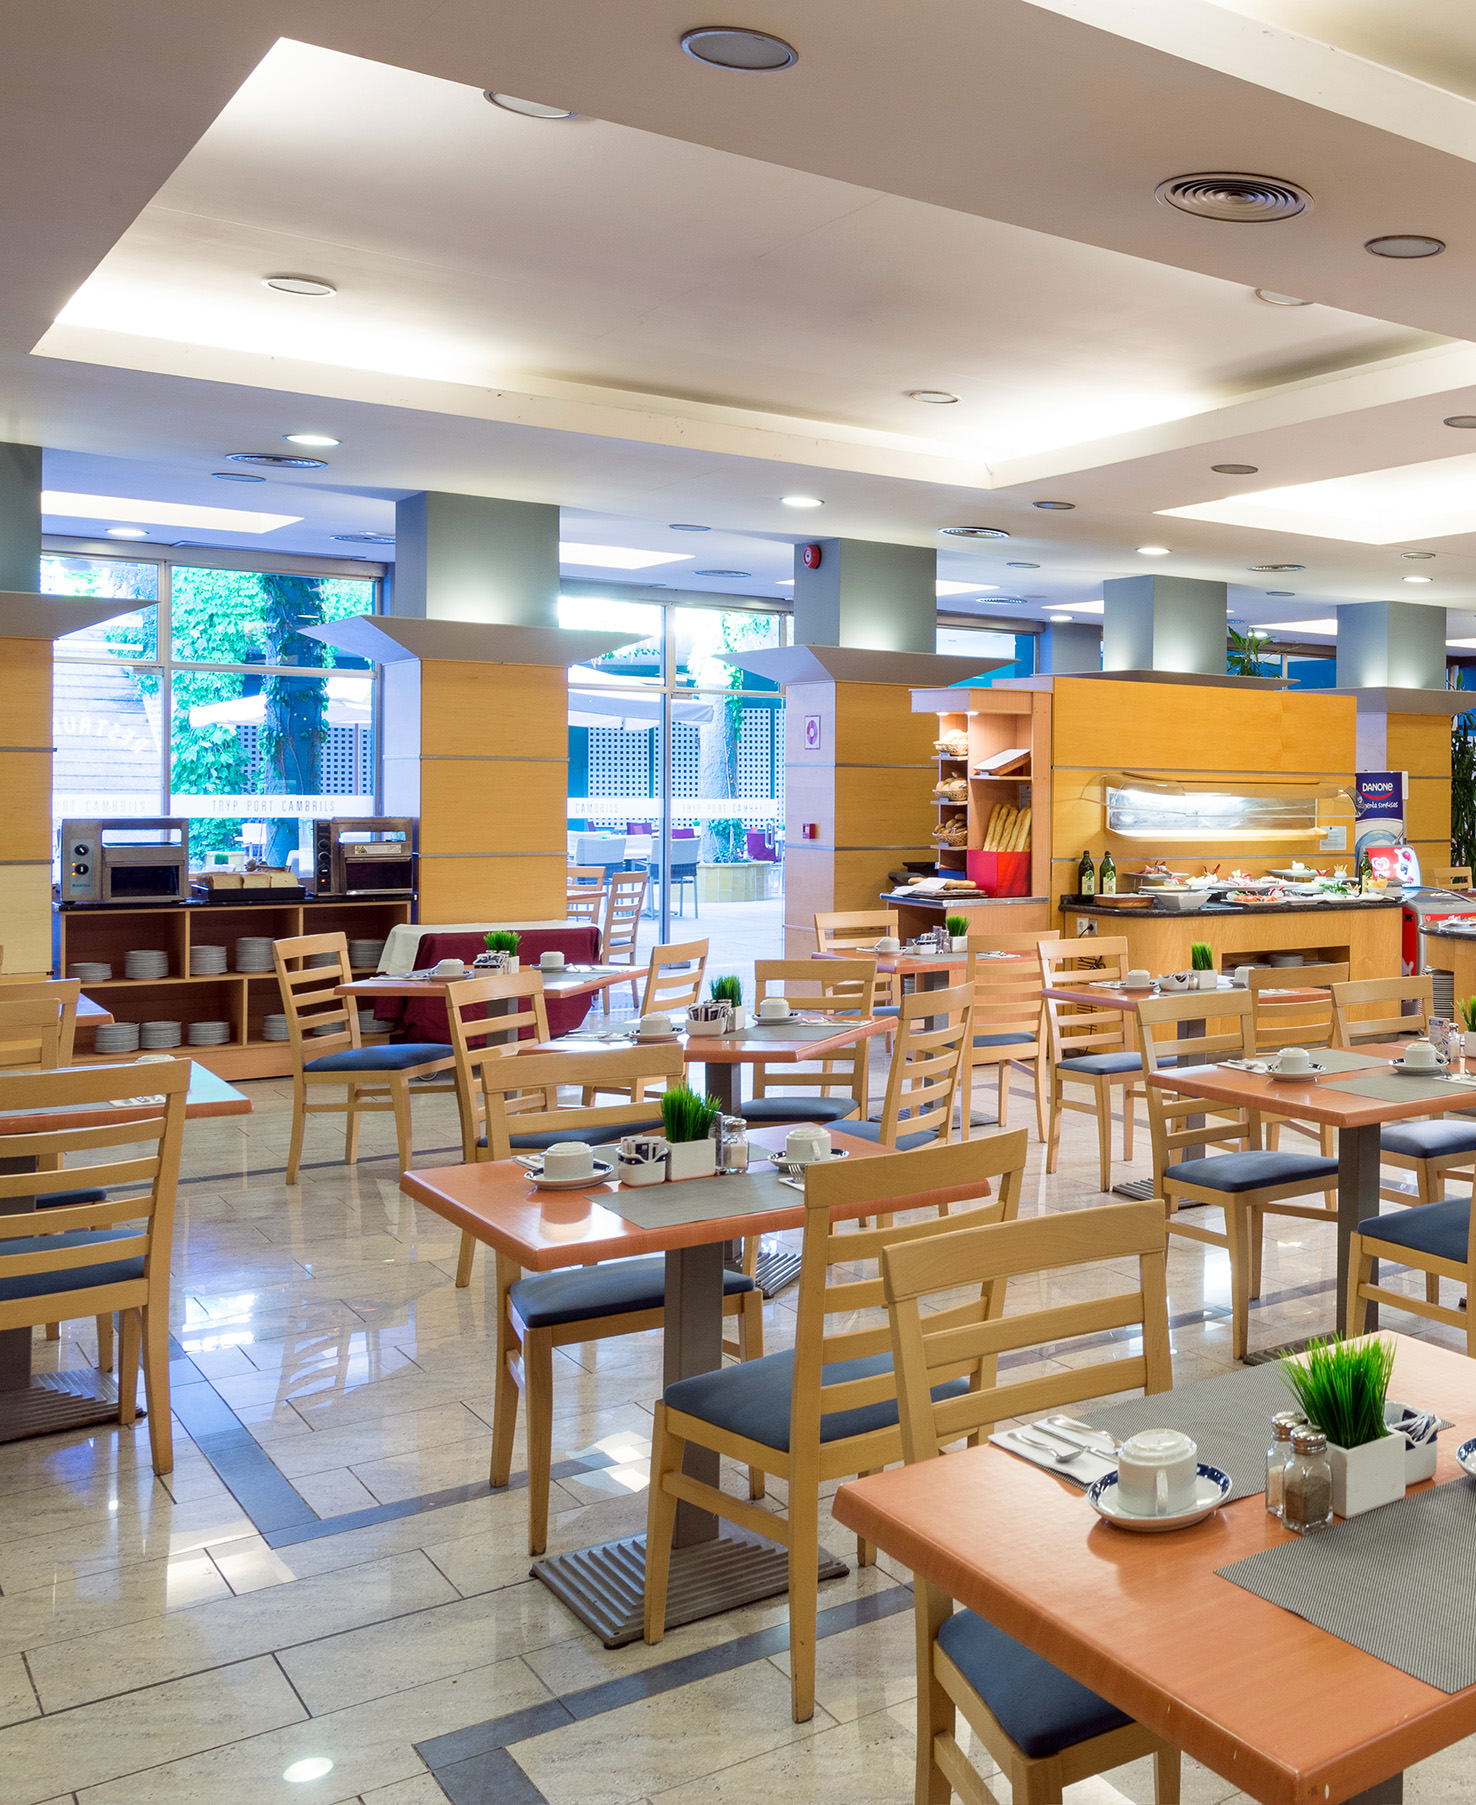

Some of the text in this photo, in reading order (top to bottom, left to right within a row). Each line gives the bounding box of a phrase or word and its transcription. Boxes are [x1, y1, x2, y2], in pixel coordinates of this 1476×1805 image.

[212, 800, 336, 813] TRYP PORT CAMBRILS
